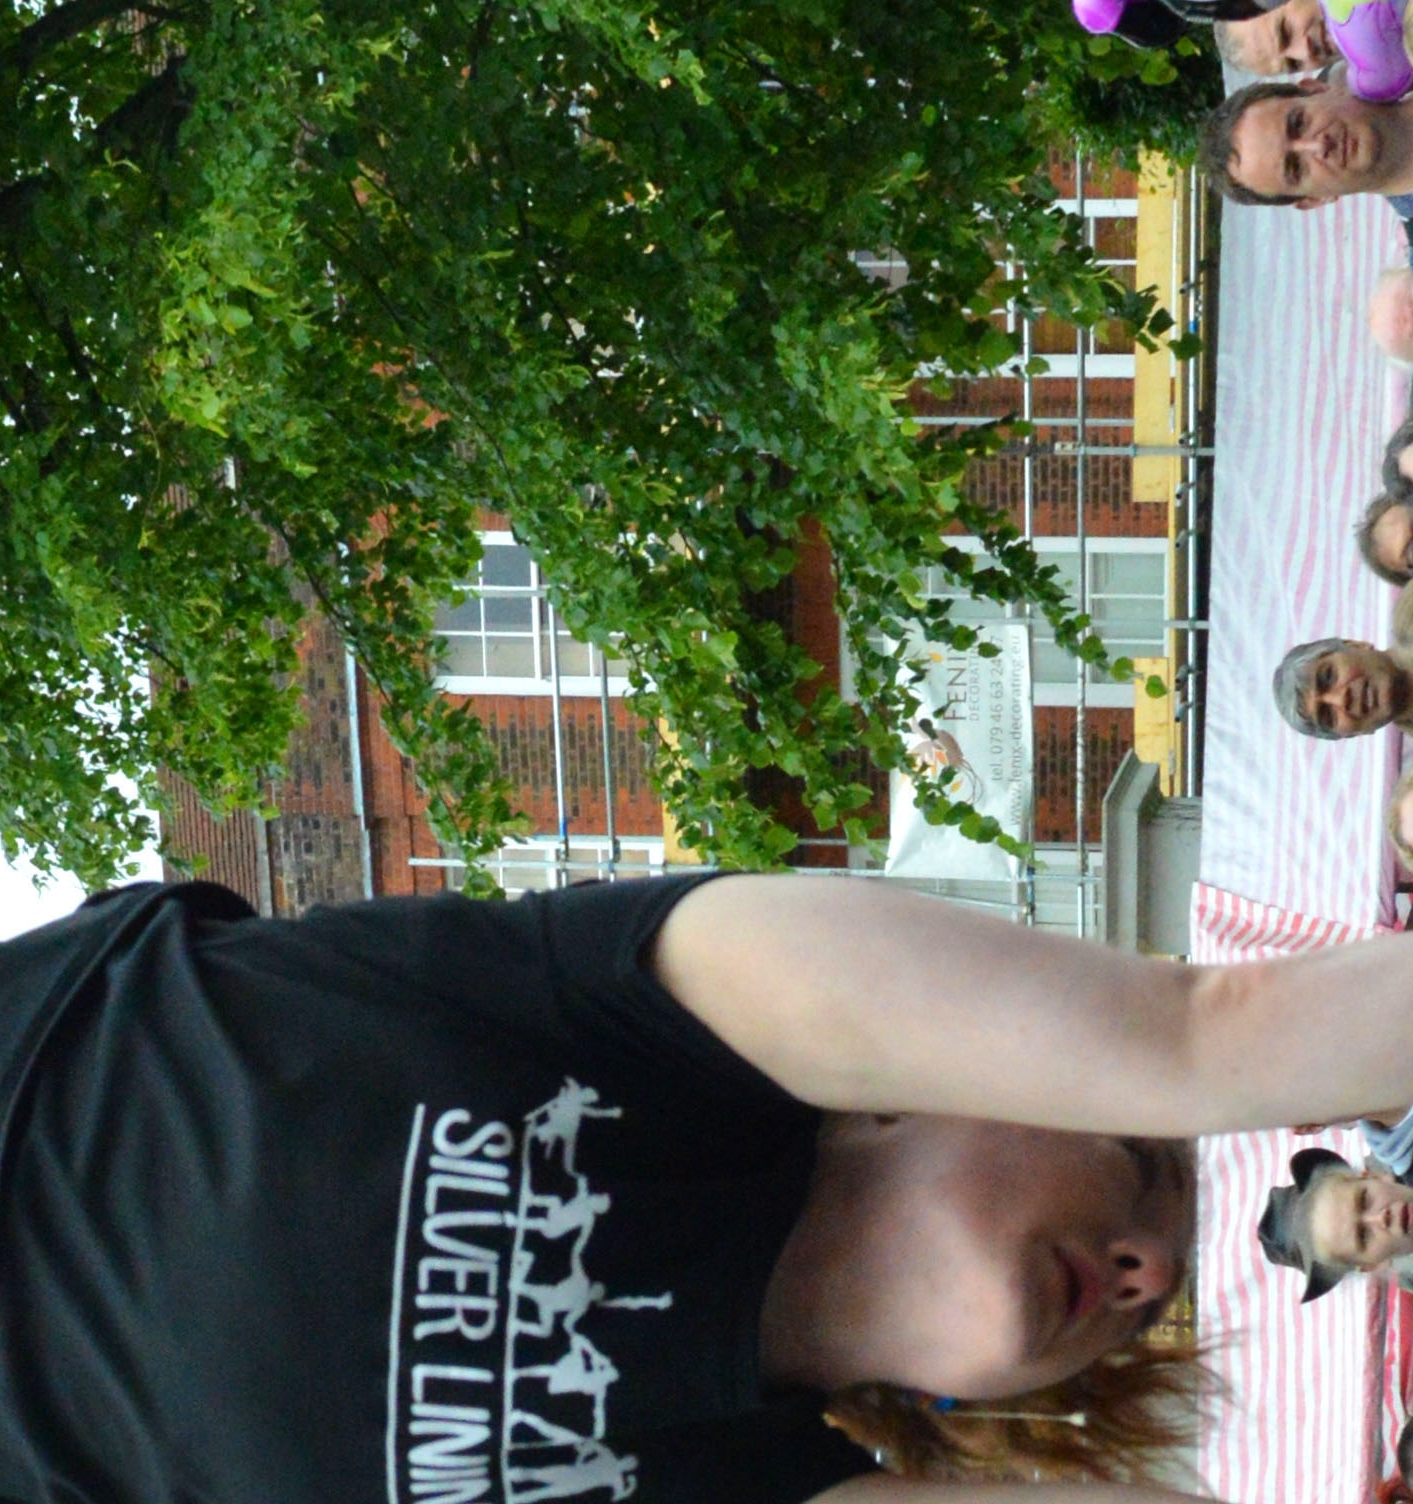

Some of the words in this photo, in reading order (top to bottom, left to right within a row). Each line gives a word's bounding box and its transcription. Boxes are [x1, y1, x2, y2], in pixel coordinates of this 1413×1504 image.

[990, 658, 1004, 677] 24
[968, 644, 981, 722] DECORATIN
[990, 680, 1004, 699] 63
[990, 703, 1004, 723] 46
[990, 726, 1004, 755] 079
[989, 759, 1003, 781] tel.
[413, 1108, 514, 1341] SILVER
